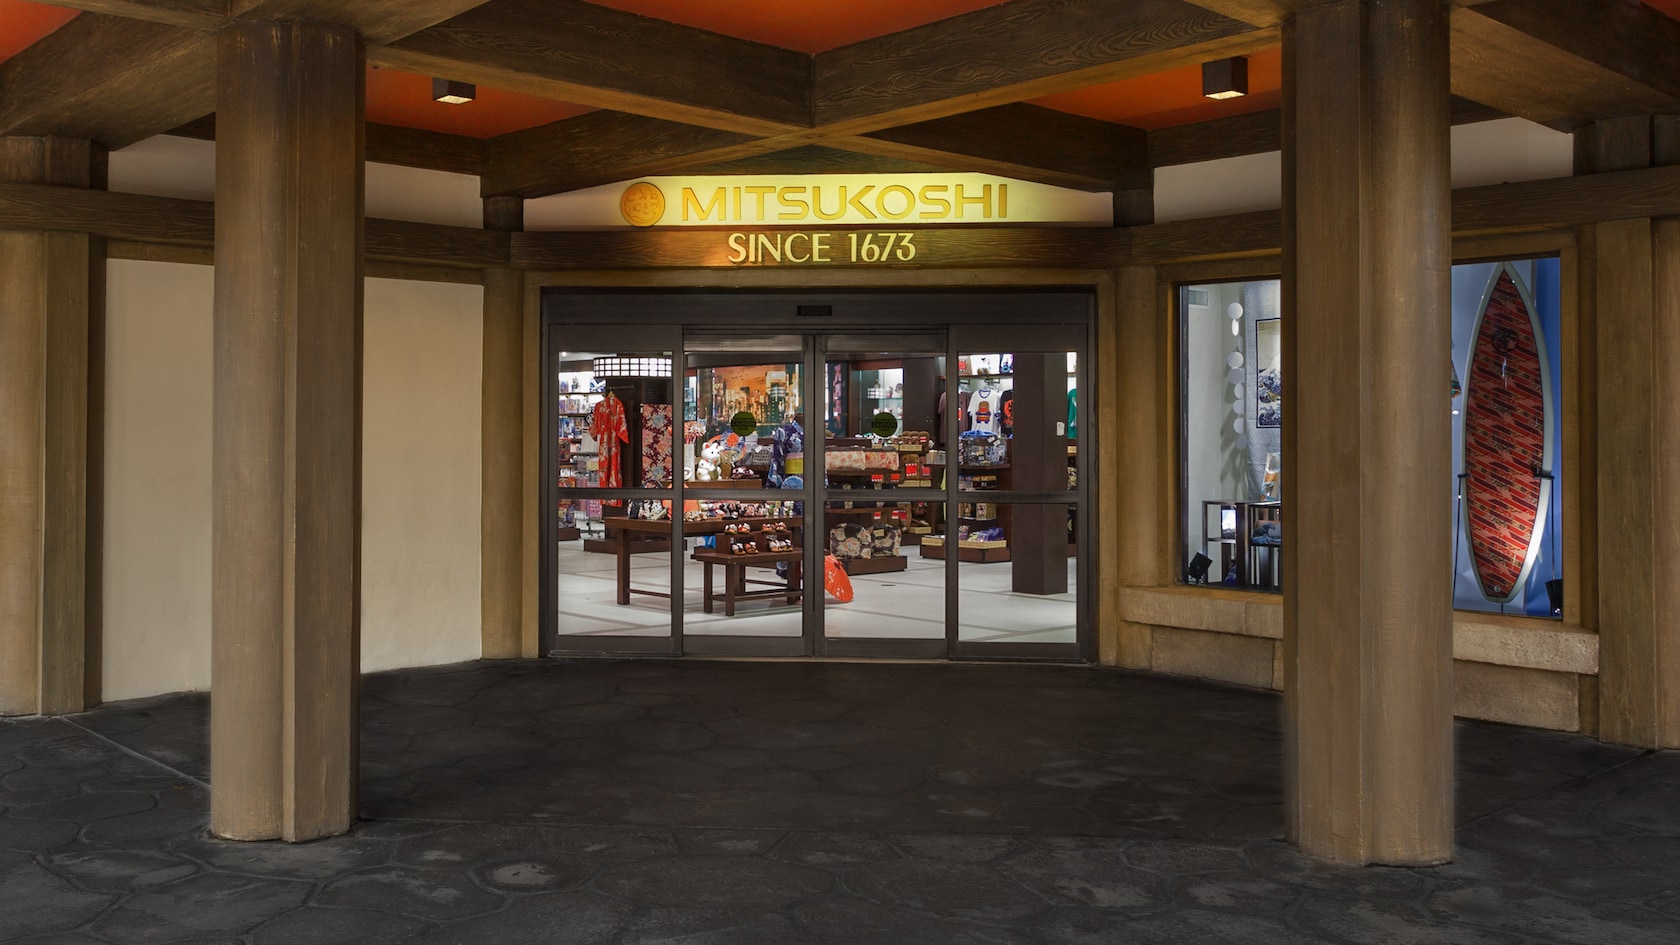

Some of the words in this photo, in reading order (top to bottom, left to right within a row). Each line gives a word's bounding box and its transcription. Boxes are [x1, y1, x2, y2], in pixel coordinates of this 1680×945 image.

[681, 184, 1008, 221] MITSUKOSHI
[727, 232, 832, 263] SINCE
[848, 232, 916, 263] 1673
